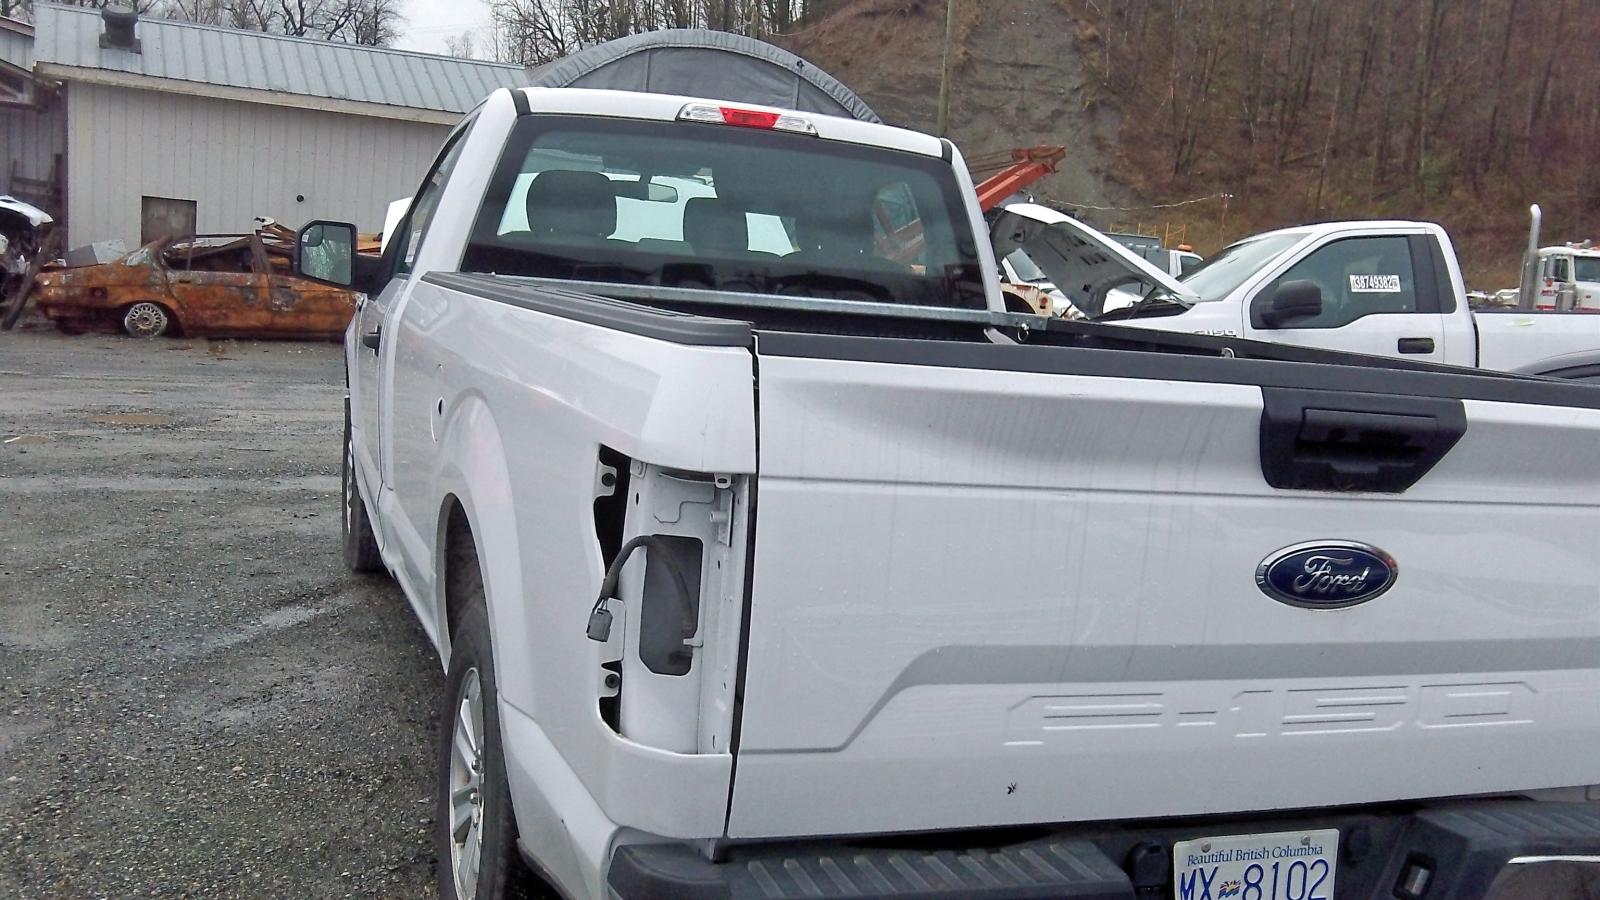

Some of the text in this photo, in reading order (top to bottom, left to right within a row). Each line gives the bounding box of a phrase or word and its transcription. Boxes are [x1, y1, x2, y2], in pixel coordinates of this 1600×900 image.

[1294, 555, 1371, 593] Ford
[1004, 681, 1539, 746] F-150
[1187, 845, 1324, 867] Beautiful British Columbia
[1179, 858, 1330, 900] MX 8102
